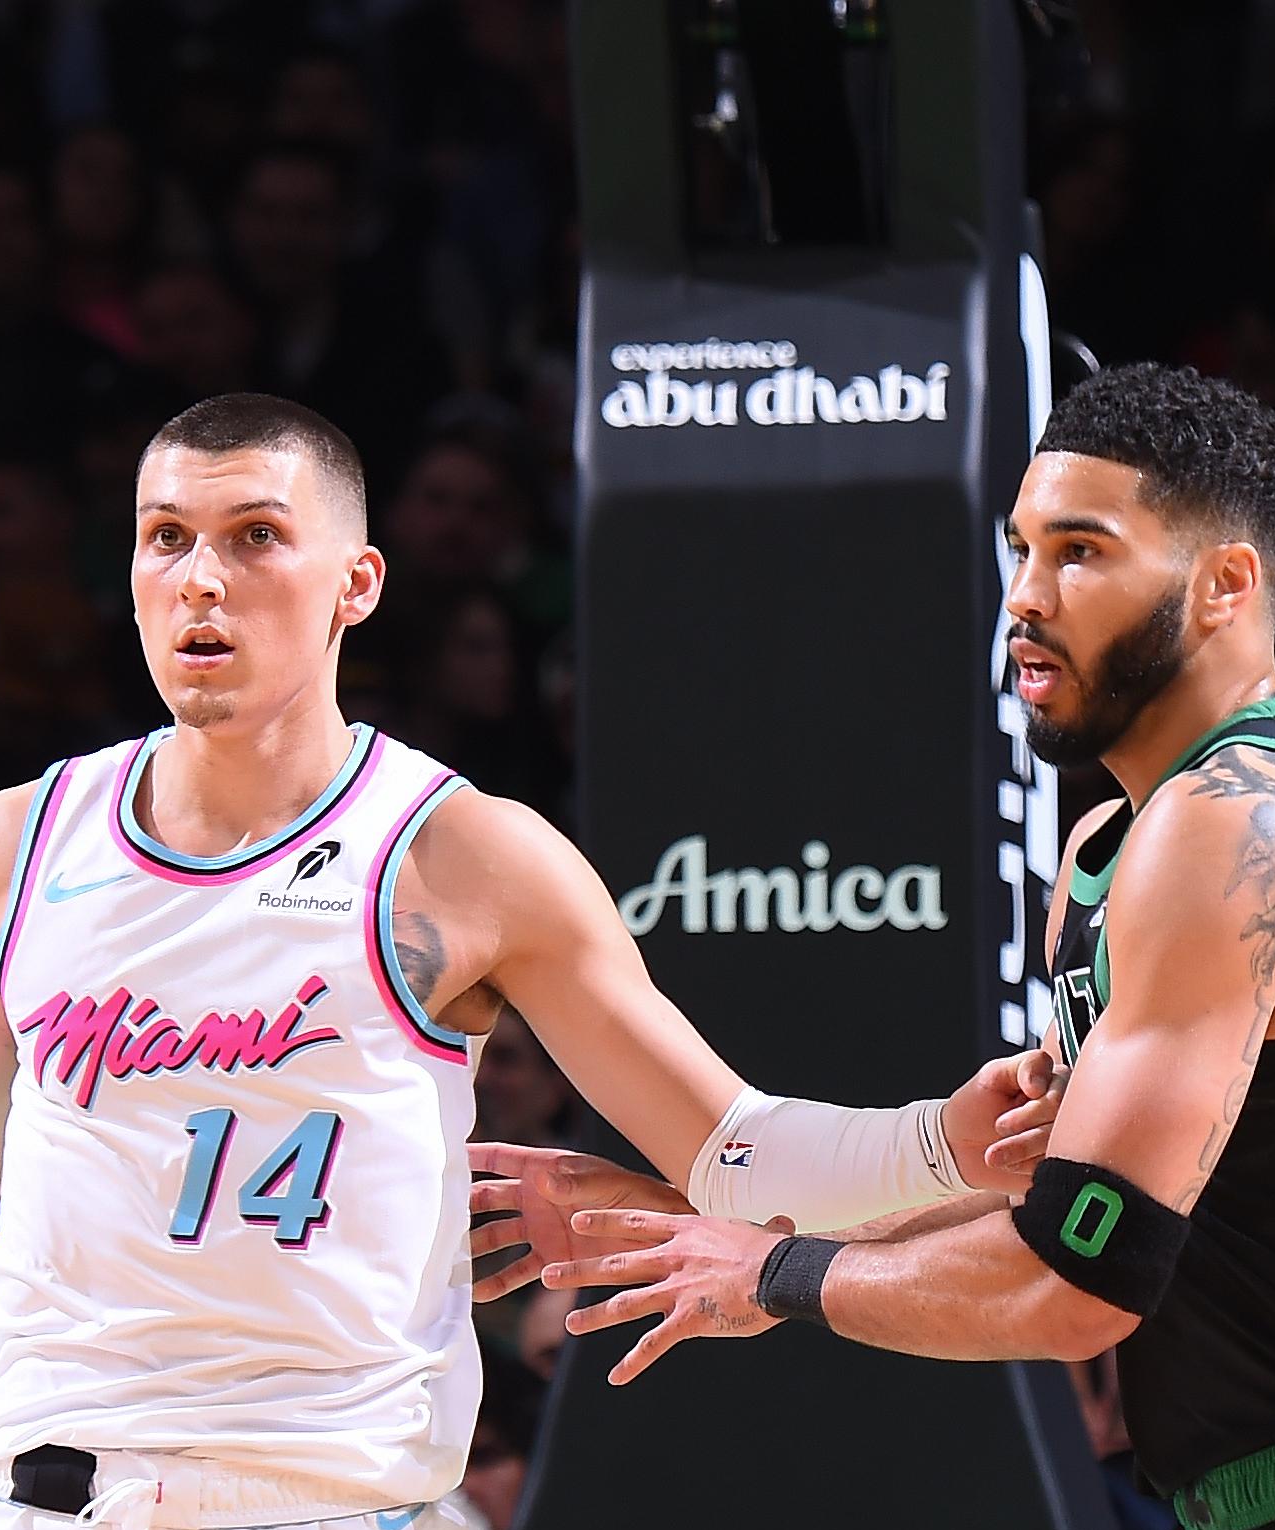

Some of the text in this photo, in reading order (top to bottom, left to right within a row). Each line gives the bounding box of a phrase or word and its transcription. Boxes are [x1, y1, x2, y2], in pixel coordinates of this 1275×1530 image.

[601, 361, 951, 427] abu dhabi
[611, 336, 798, 371] experience
[258, 892, 353, 912] Robinhood
[616, 835, 948, 936] Amica
[17, 975, 345, 1111] Miami
[167, 1107, 345, 1253] 14
